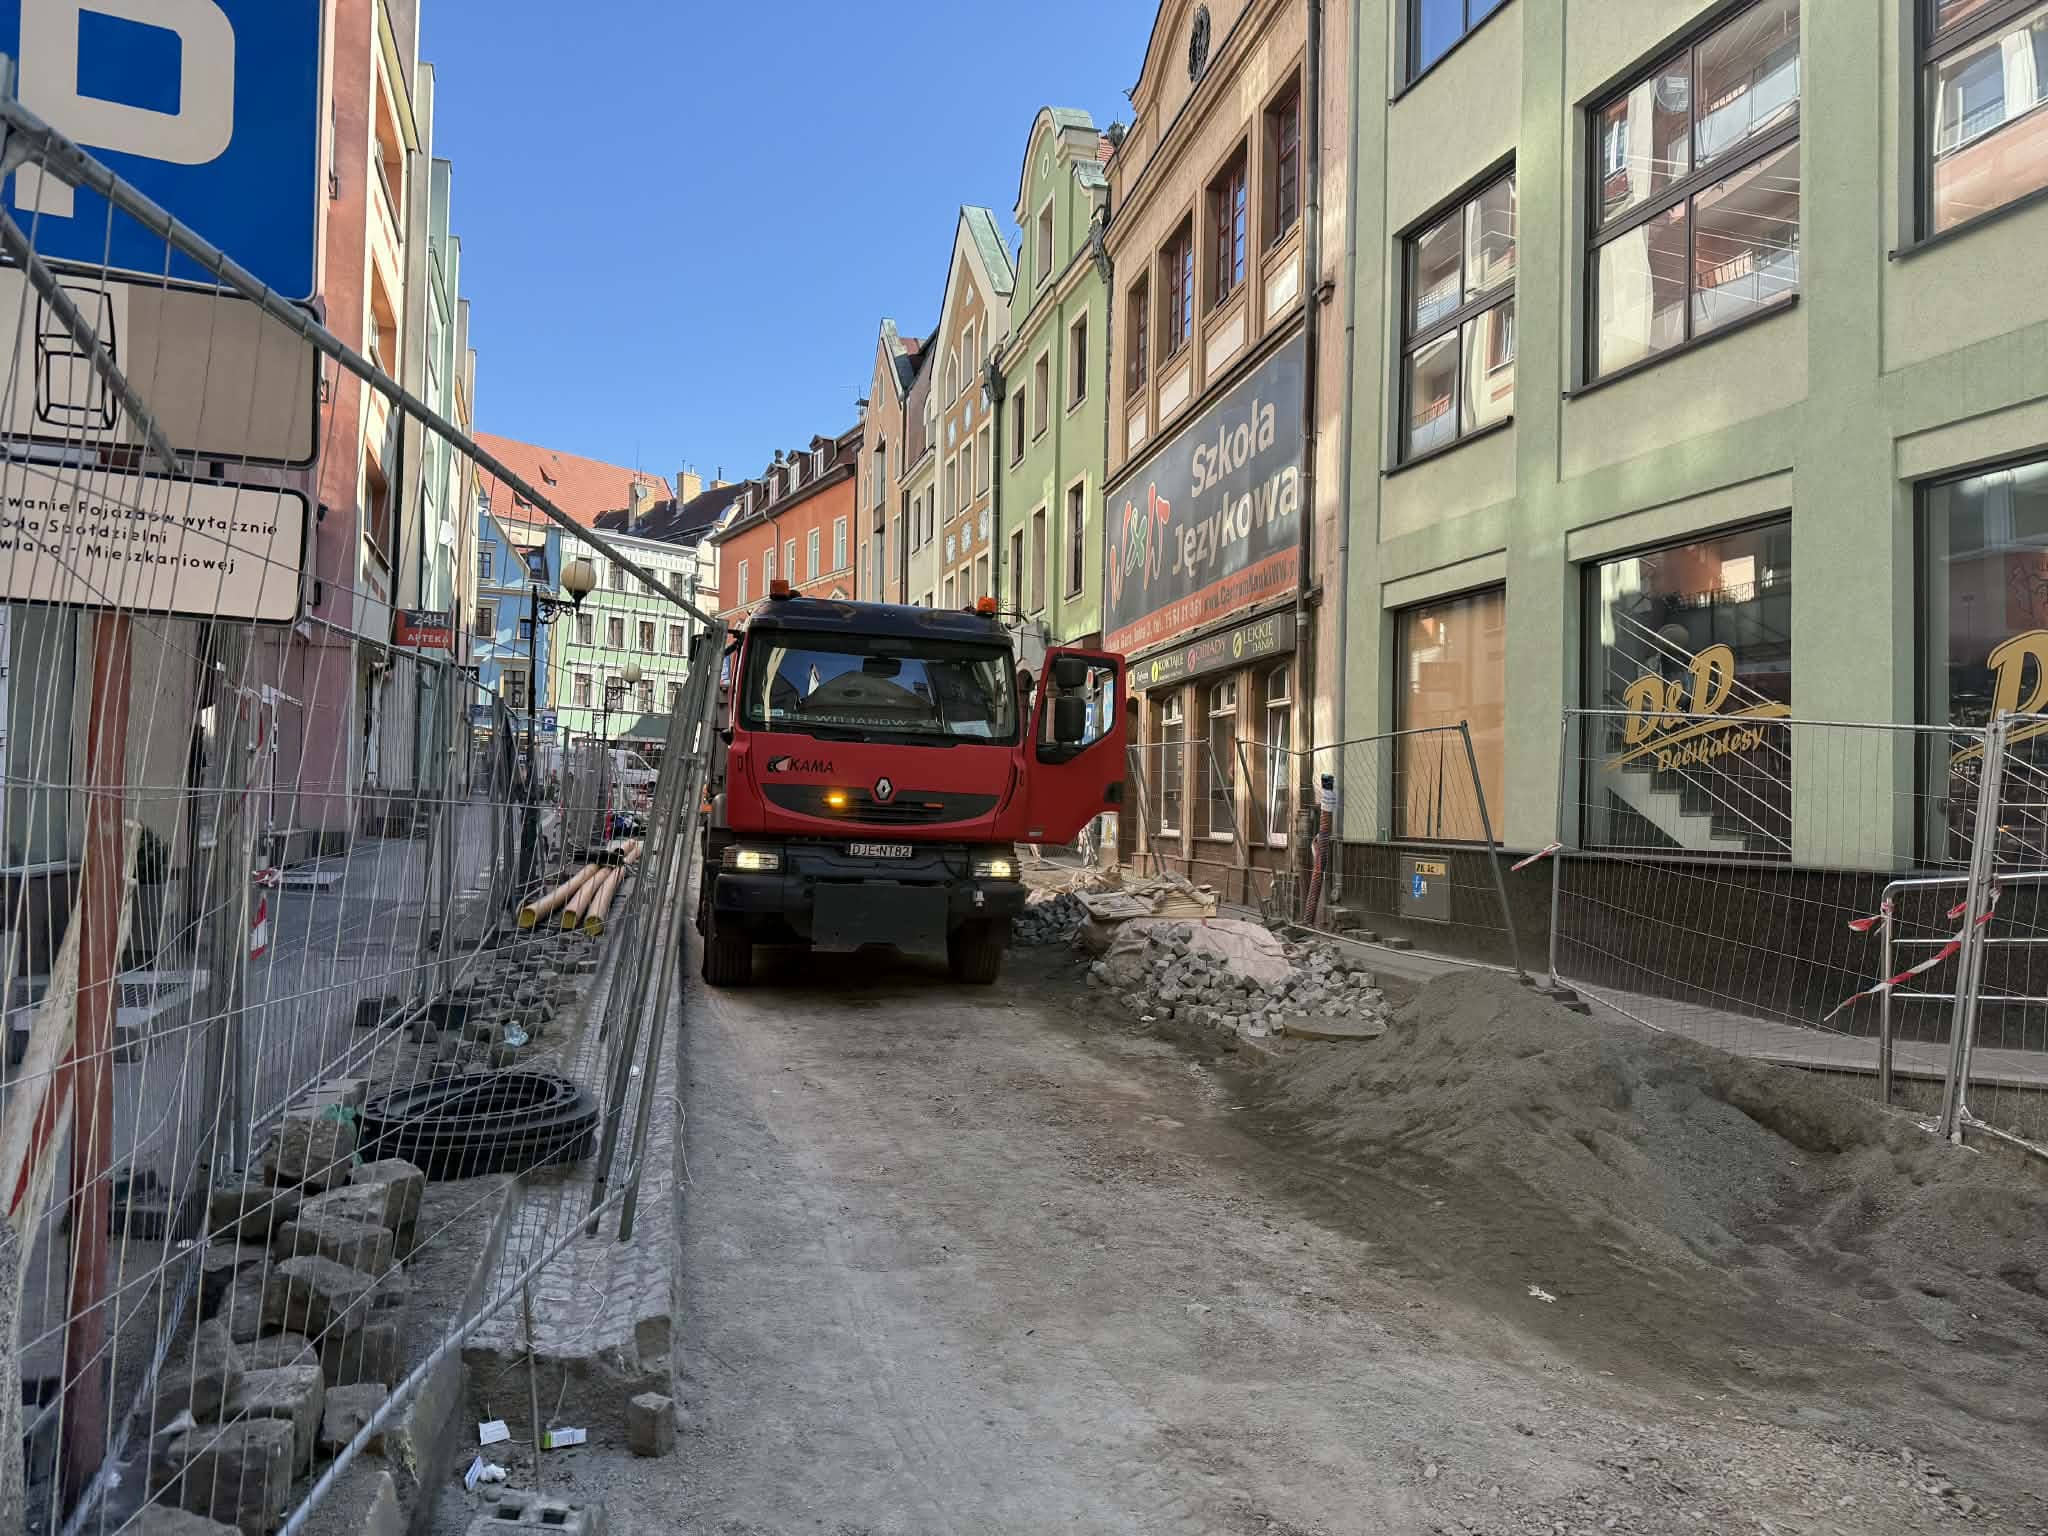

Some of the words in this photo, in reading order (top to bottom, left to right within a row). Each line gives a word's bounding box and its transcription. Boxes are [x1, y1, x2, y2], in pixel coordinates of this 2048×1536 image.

[15, 0, 235, 218] P
[1191, 398, 1275, 498] Szkoła
[0, 494, 71, 514] wanie
[182, 513, 278, 537] wyłącznie
[1171, 465, 1298, 578] Językowa
[407, 633, 449, 643] APTEKA
[413, 613, 445, 625] 24H
[1243, 618, 1273, 645] LEKKIE
[1253, 637, 1275, 653] DANIA
[1622, 643, 1735, 744] D&D
[789, 757, 834, 774] KAMA
[1657, 726, 1765, 773] Delikatesy
